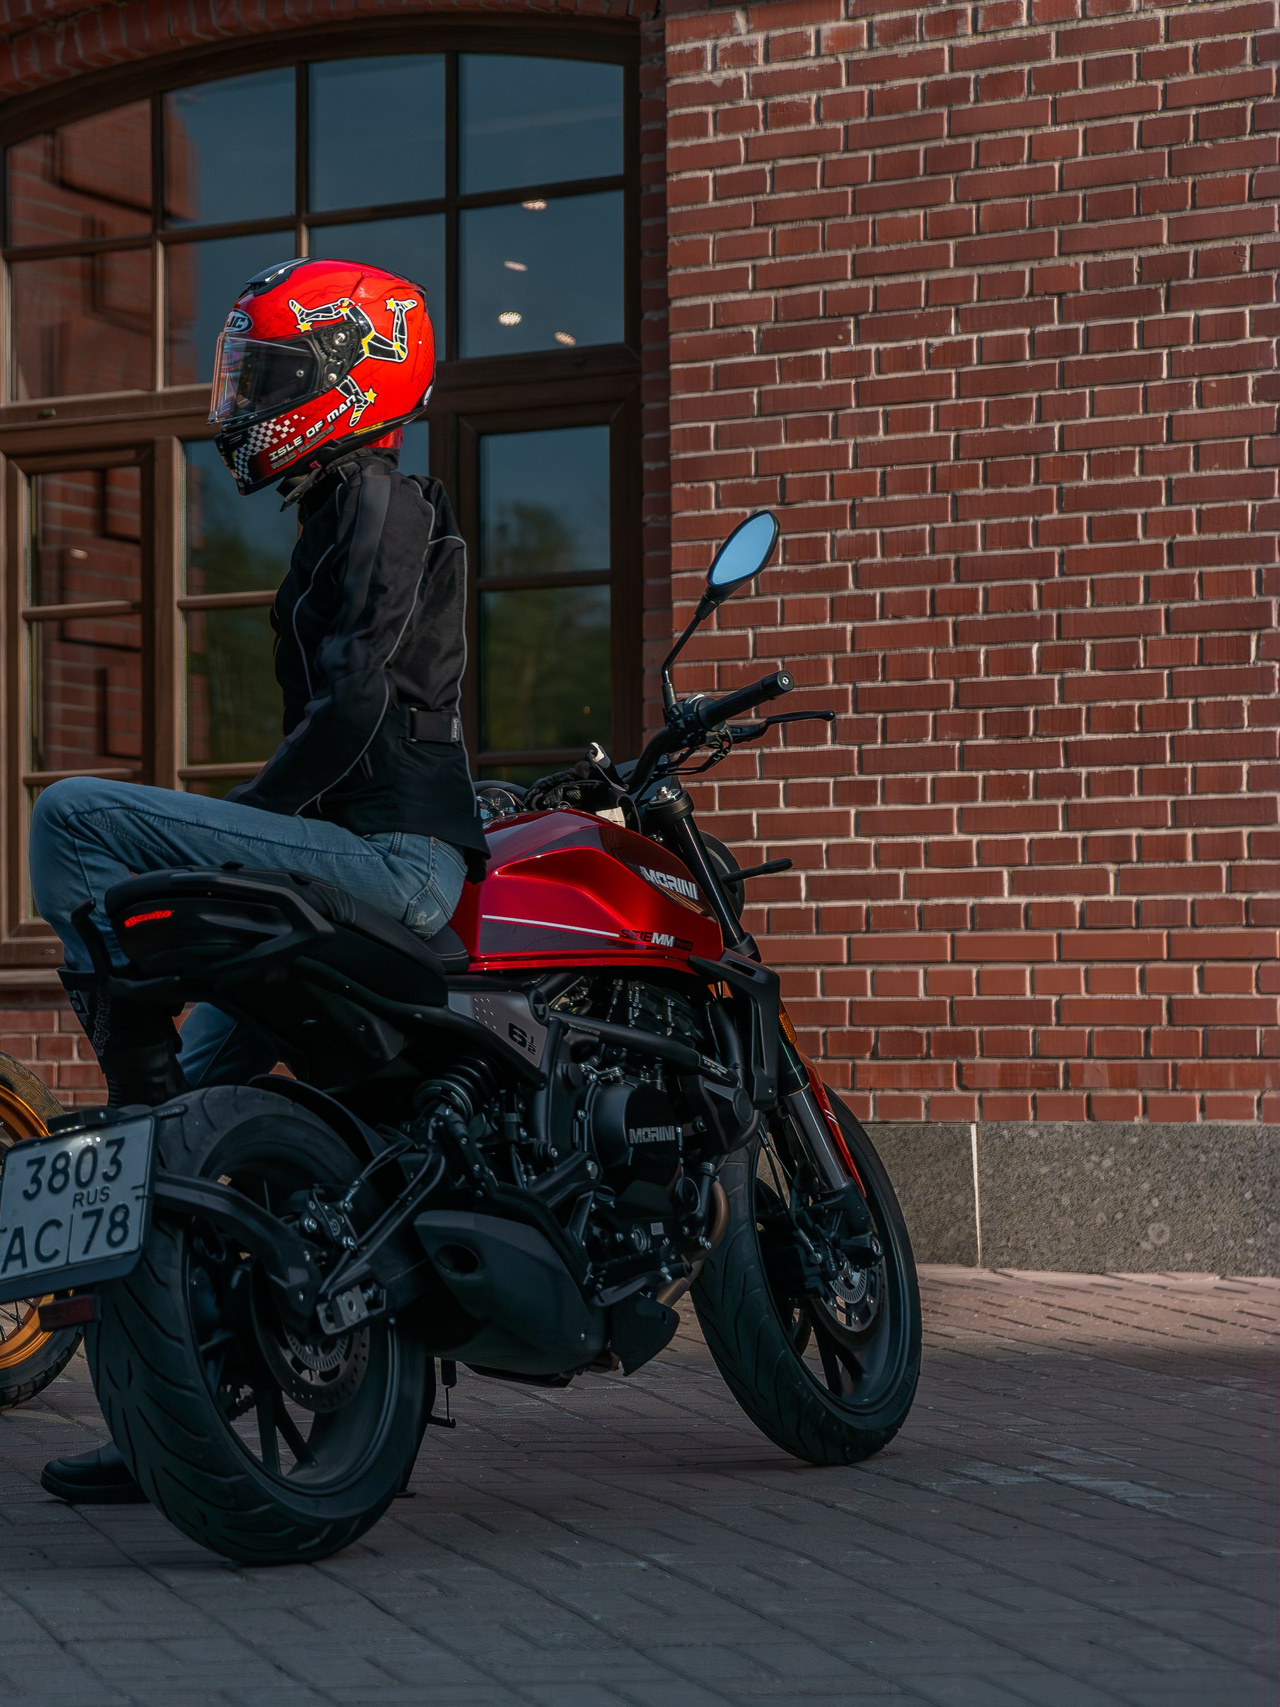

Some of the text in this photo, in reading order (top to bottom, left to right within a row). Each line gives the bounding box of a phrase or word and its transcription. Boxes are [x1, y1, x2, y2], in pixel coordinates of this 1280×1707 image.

[269, 435, 304, 462] ISLE
[305, 420, 325, 439] OF
[327, 394, 357, 423] MAN
[639, 865, 699, 901] MORINI
[628, 1125, 676, 1144] MORINI
[22, 1136, 126, 1201] 3803
[72, 1185, 111, 1209] RUS
[0, 1203, 131, 1274] AC 78
